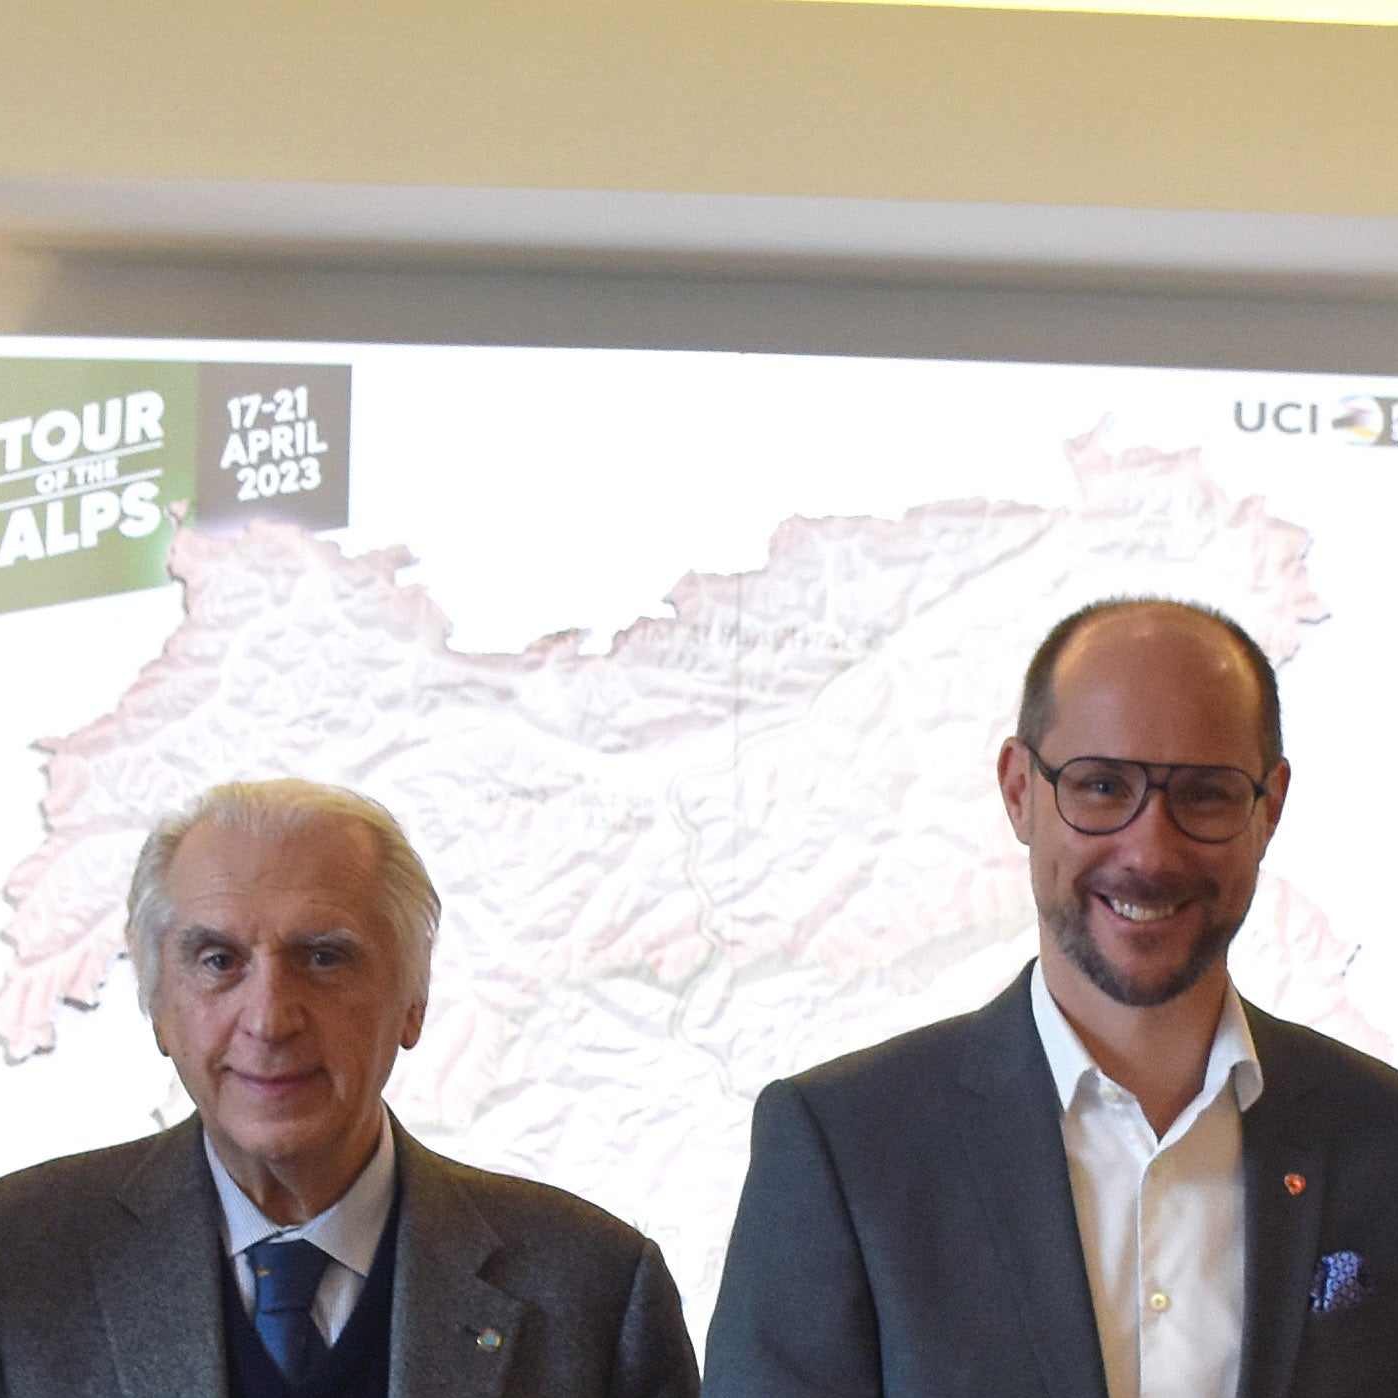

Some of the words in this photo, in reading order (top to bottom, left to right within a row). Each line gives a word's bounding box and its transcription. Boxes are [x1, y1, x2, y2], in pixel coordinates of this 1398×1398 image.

[226, 385, 309, 430] 17-21
[1234, 400, 1318, 434] UCI
[220, 421, 329, 470] APRIL
[35, 469, 69, 497] OF
[73, 456, 119, 487] THE
[235, 456, 322, 502] 2023
